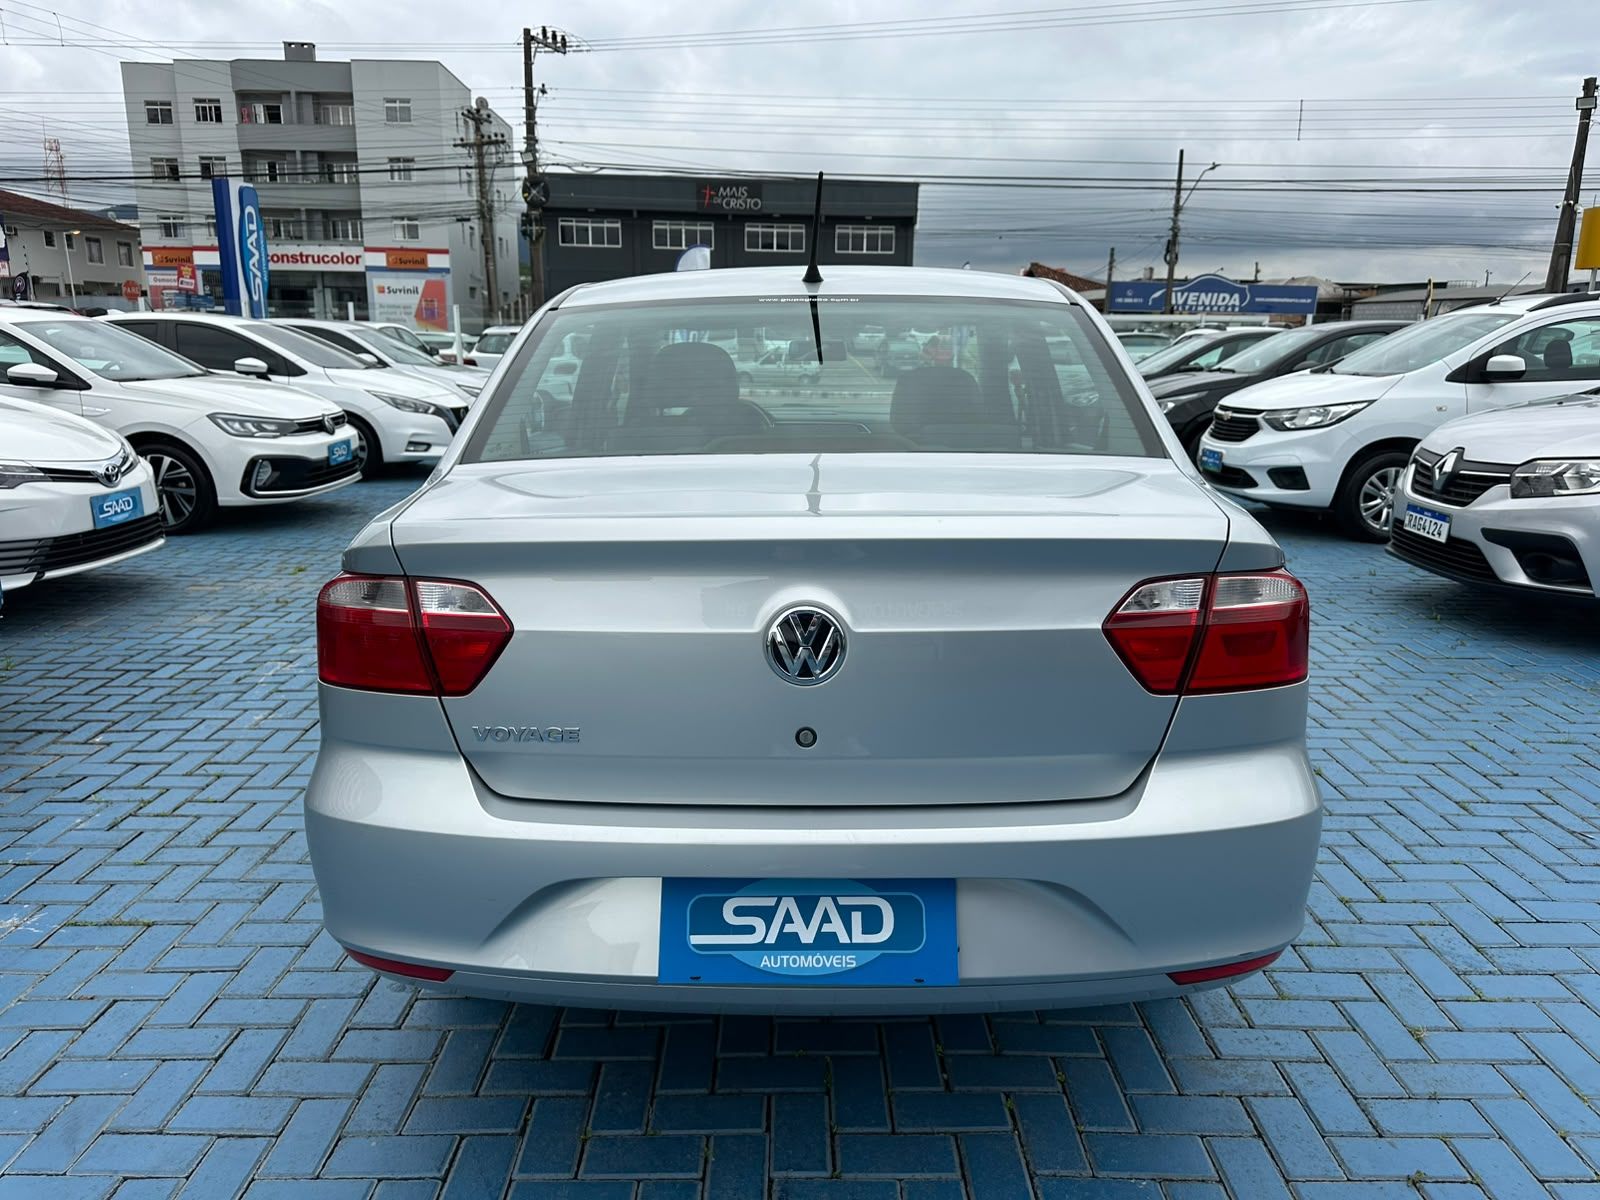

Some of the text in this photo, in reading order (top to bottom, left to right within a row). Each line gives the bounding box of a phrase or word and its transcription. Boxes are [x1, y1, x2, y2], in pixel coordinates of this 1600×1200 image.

[718, 186, 748, 198] MAIS
[722, 197, 762, 210] CRISTO
[245, 205, 263, 301] SAAD
[386, 285, 419, 295] Suvinil
[99, 496, 133, 518] SAAD
[1408, 513, 1442, 538] RAG4I24
[471, 726, 581, 743] VOYAGE
[689, 896, 895, 945] SAAD
[760, 952, 857, 969] AUTOMÓVEIS
